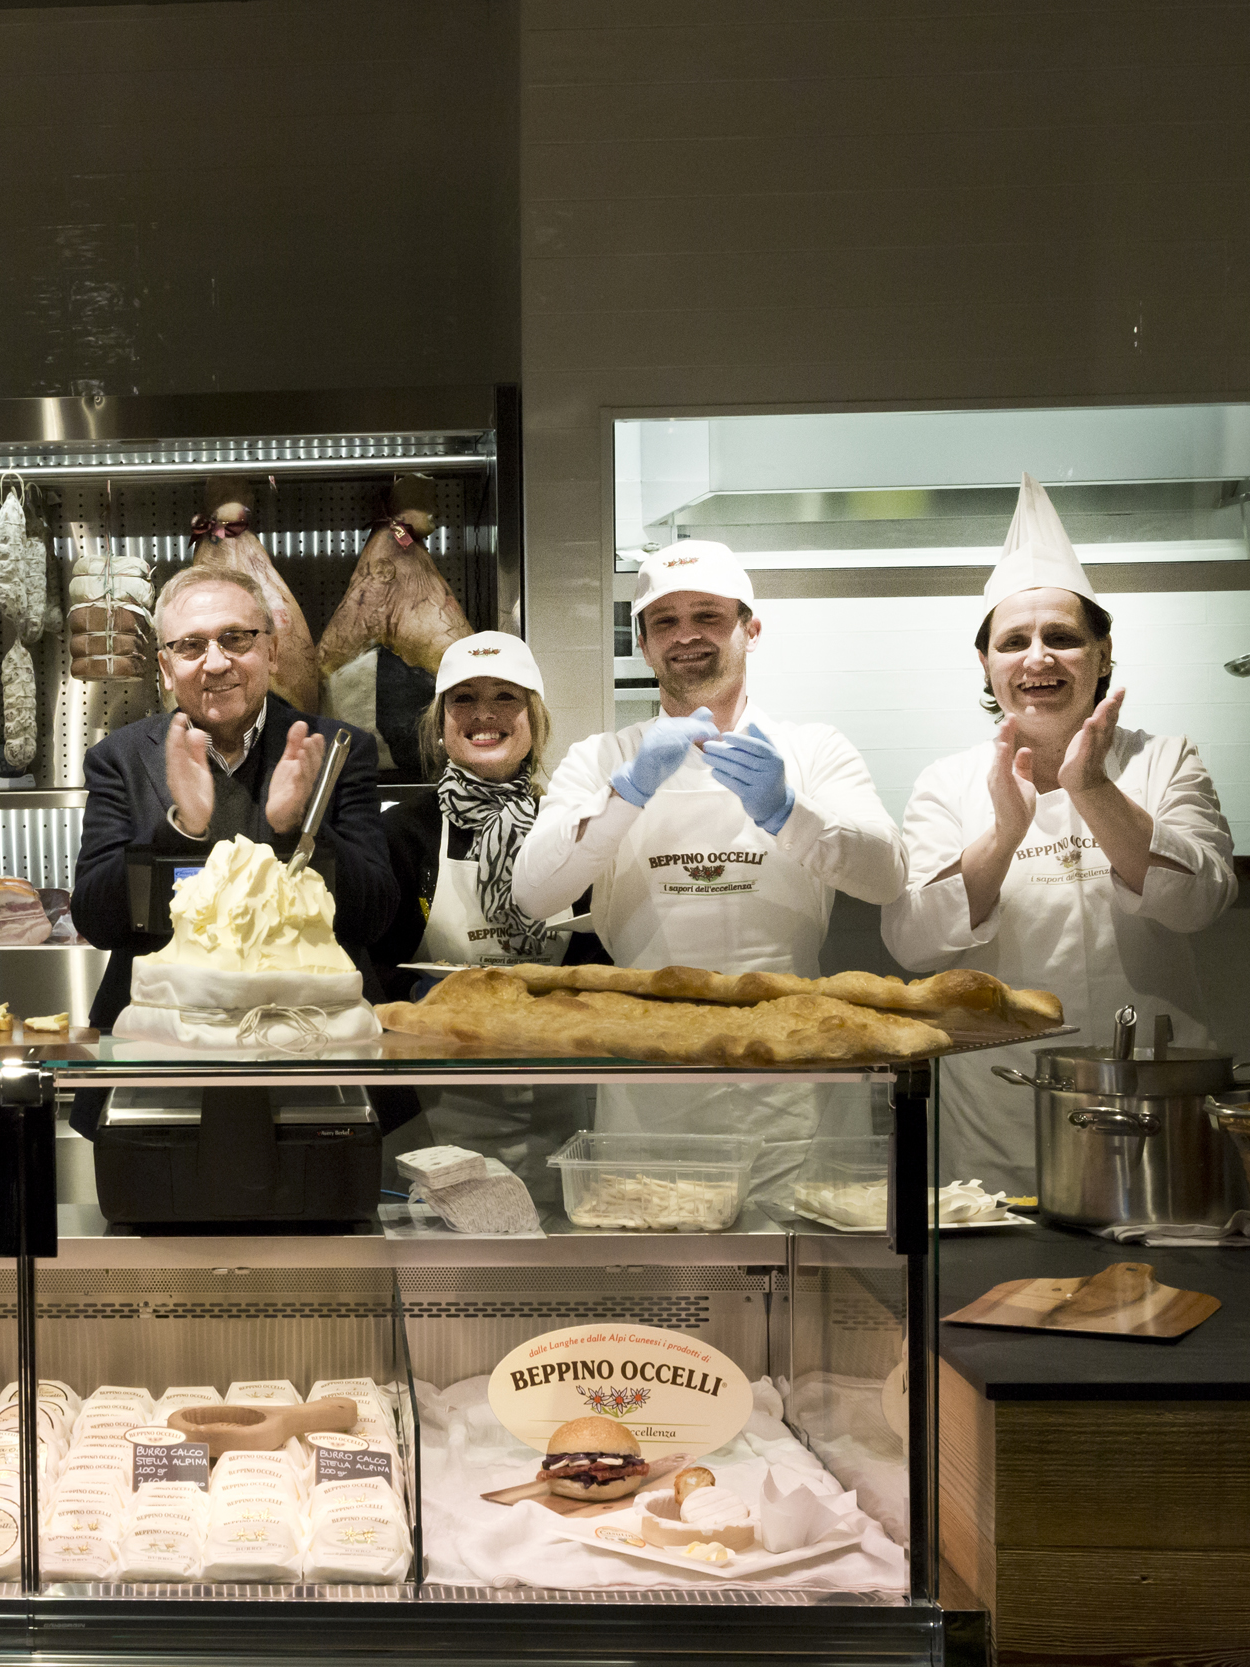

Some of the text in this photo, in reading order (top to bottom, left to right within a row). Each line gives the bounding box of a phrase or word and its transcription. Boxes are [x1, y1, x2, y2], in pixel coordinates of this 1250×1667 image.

[1016, 837, 1069, 861] BEPPINO
[649, 851, 764, 869] BEPPINO OCCELLI
[1036, 874, 1064, 884] sapori
[663, 883, 752, 894] i sapori dell'eccellenza
[529, 1341, 548, 1358] dalle
[549, 1336, 579, 1351] Langhe
[586, 1334, 607, 1343] dalle
[608, 1333, 626, 1343] Alpi
[629, 1334, 661, 1347] Cuneesi
[662, 1340, 666, 1348] i
[667, 1341, 702, 1359] prodotti
[701, 1352, 712, 1363] di
[510, 1359, 723, 1397] BEPPINO OCCELLI
[155, 1430, 182, 1439] OCCELLI
[337, 1437, 364, 1447] OCCELLI
[136, 1446, 167, 1456] BURRO
[170, 1449, 204, 1457] CALCO
[136, 1457, 208, 1466] STELLA ALPINA
[228, 1454, 282, 1464] BEPPINO OCCELLI
[319, 1450, 387, 1465] BURRO CALCO
[319, 1459, 390, 1473] STELLA ALPINA
[319, 1467, 336, 1475] 200
[228, 1468, 282, 1478] BEPPINO OCCELLI
[221, 1481, 276, 1491] BEPPINO OCCELLI
[324, 1482, 379, 1494] BEPPINO OCCELLI
[227, 1497, 283, 1507] BEPPINO OCCELLI
[58, 1509, 112, 1518] BEPPINO OCCELLI
[136, 1512, 191, 1521] BEPPINO OCCELLI
[331, 1516, 389, 1525] BEPPINO OCCELLI
[135, 1529, 189, 1538] BEPPINO OCCELLI
